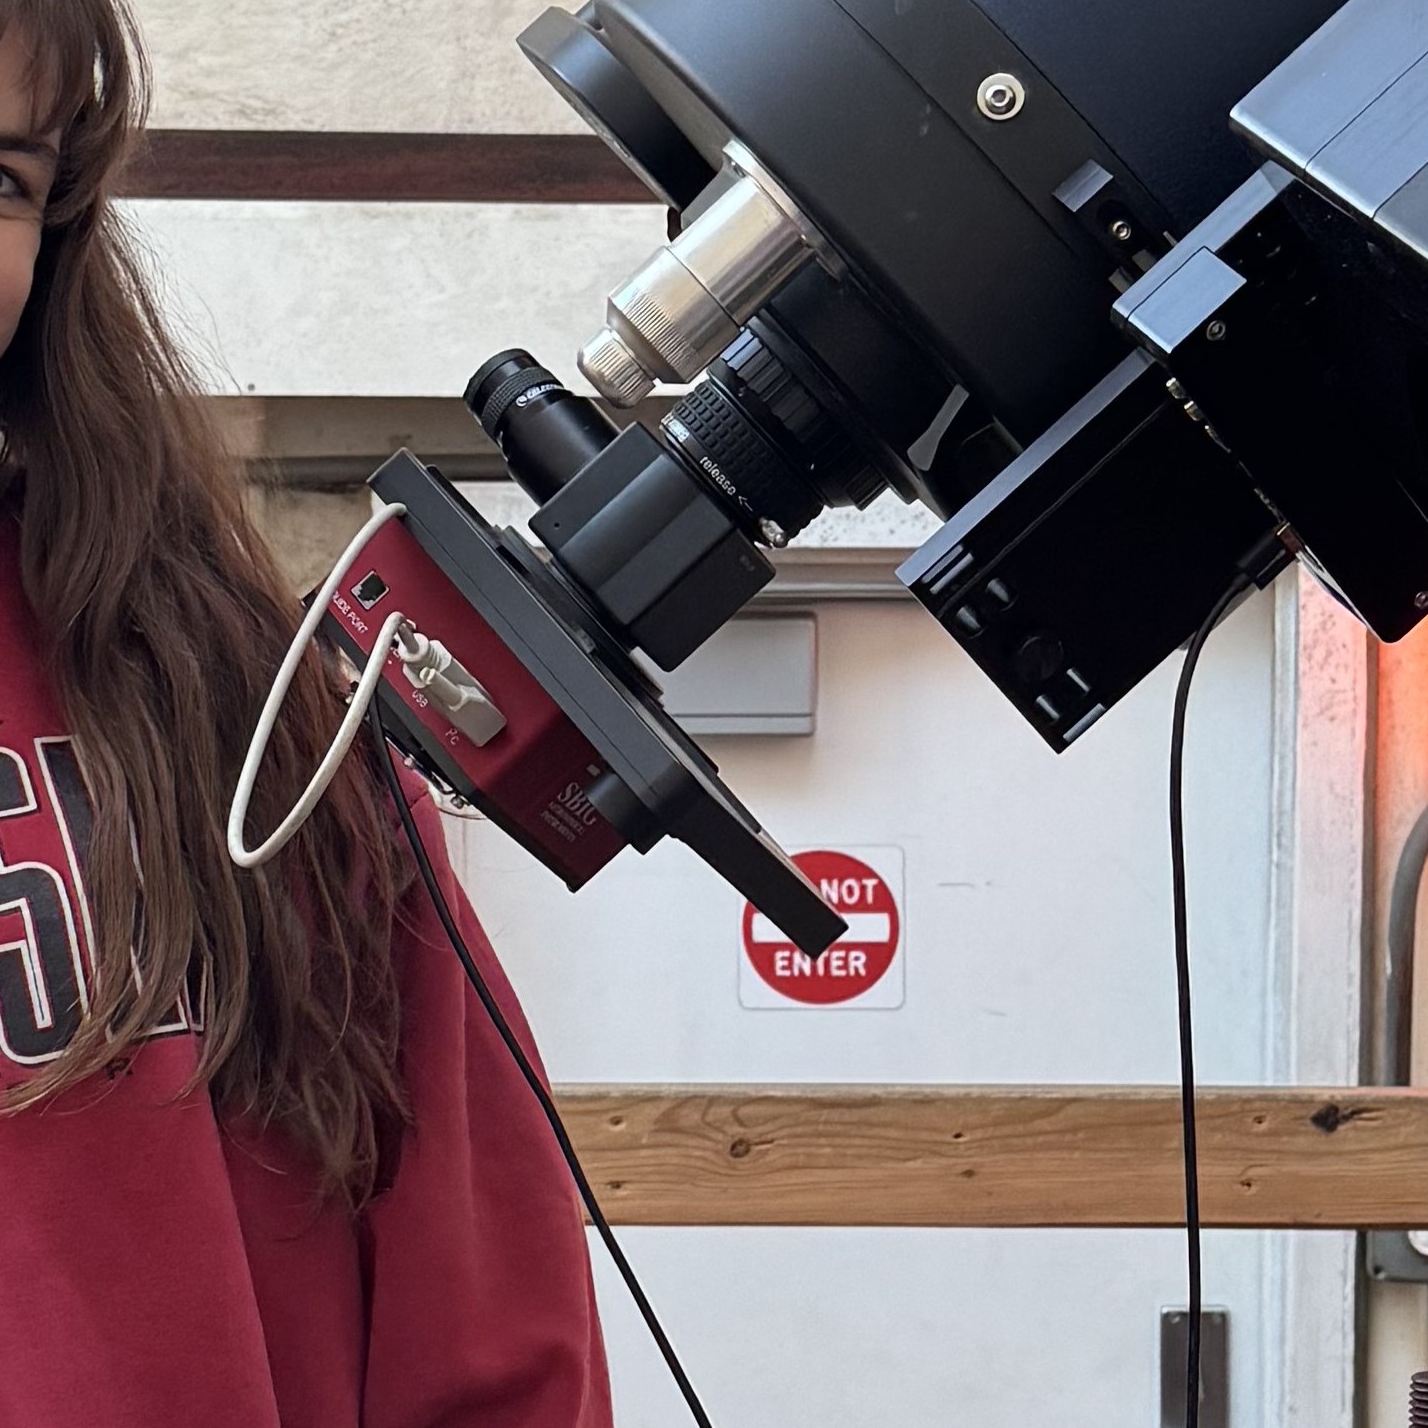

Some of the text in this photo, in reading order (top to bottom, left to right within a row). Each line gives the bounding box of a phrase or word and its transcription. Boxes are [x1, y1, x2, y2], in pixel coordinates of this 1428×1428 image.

[700, 456, 737, 496] release
[412, 690, 428, 708] USB
[820, 878, 879, 905] NOT
[774, 950, 866, 977] ENTER
